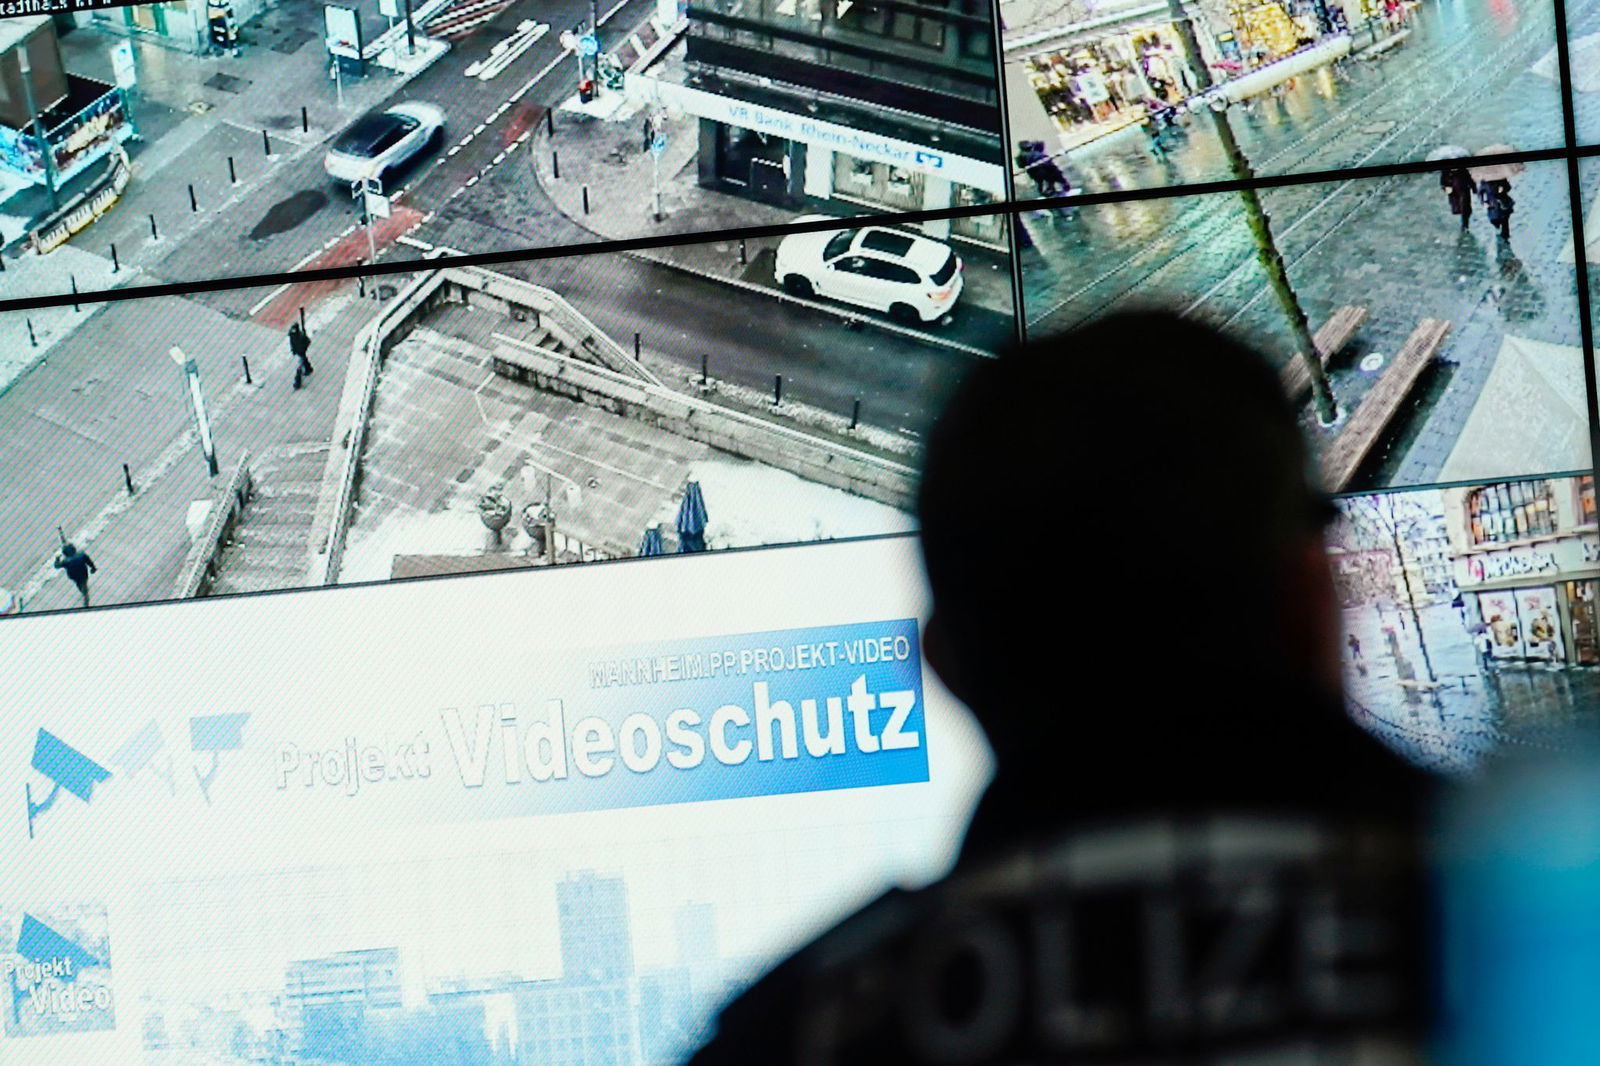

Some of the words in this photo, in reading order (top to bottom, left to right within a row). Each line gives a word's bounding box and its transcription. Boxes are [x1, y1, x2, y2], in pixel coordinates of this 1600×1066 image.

[276, 729, 432, 797] Projekt
[440, 674, 921, 789] Videoschutz
[4, 956, 73, 984] Projekt
[29, 983, 112, 1015] Video
